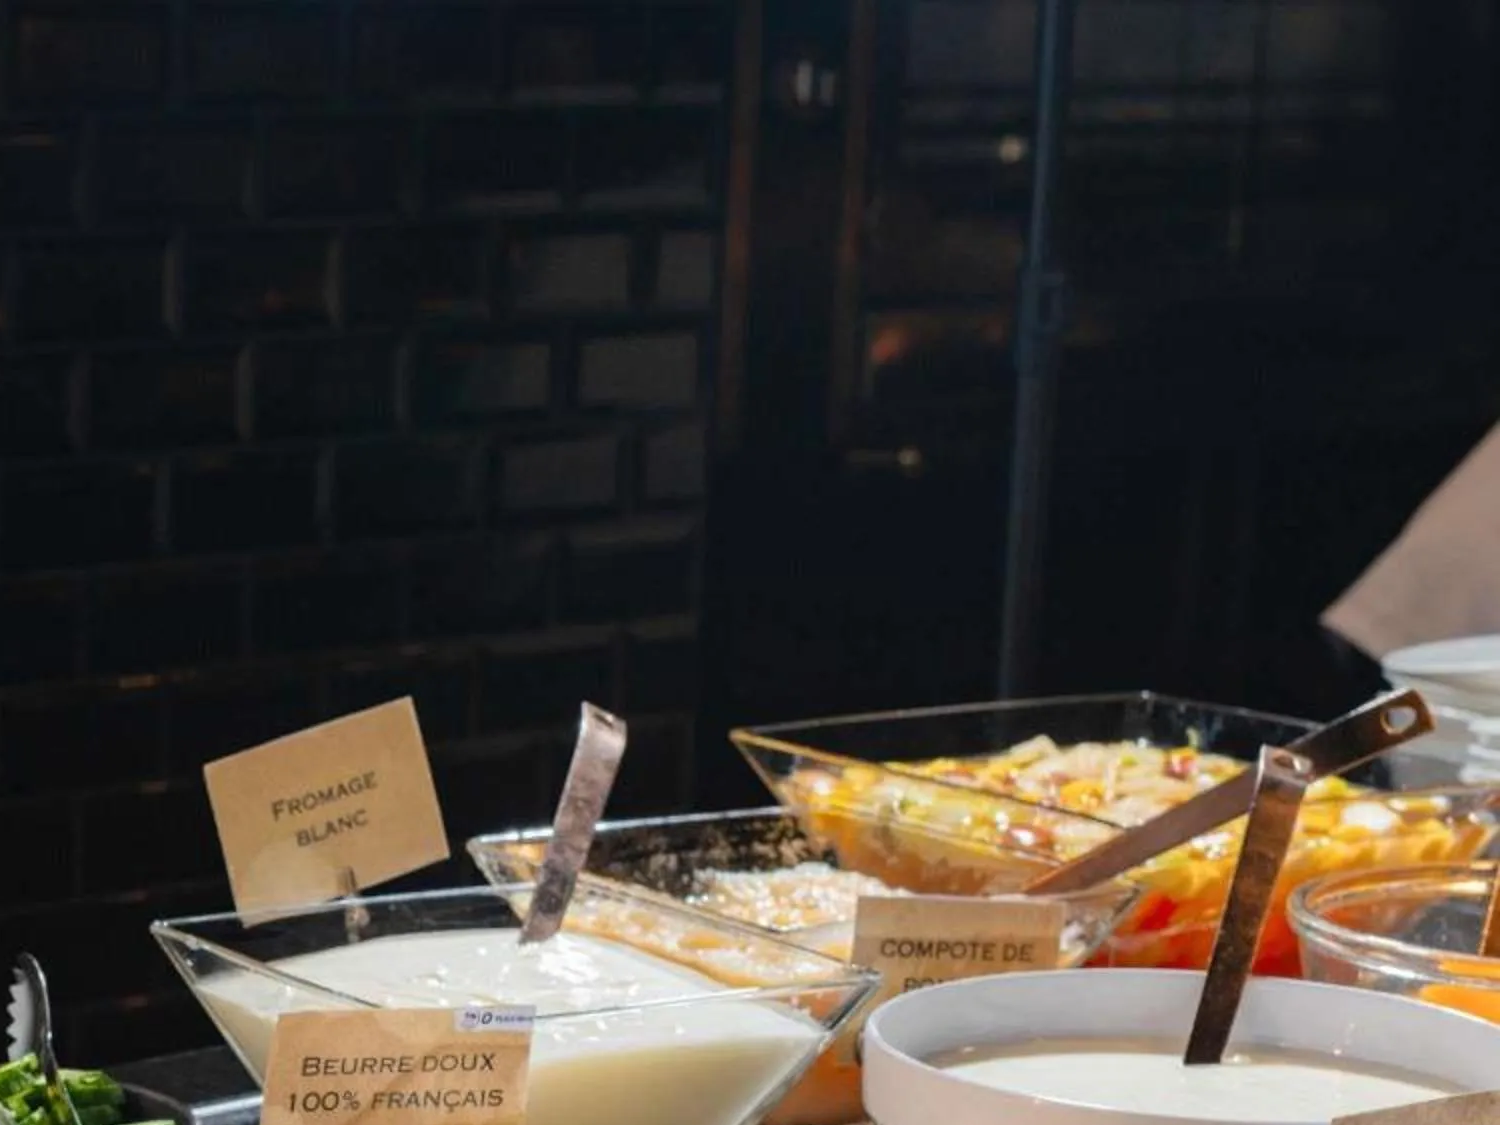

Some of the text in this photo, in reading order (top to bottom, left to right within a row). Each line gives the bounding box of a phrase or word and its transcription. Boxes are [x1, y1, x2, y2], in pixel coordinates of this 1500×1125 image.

[271, 771, 379, 822] FROMAGE
[296, 809, 369, 848] BLANC
[880, 938, 1035, 963] COMPOTE DE
[301, 1052, 497, 1078] BEURRE DOUX
[287, 1089, 505, 1114] 100% FRANÇAIS
